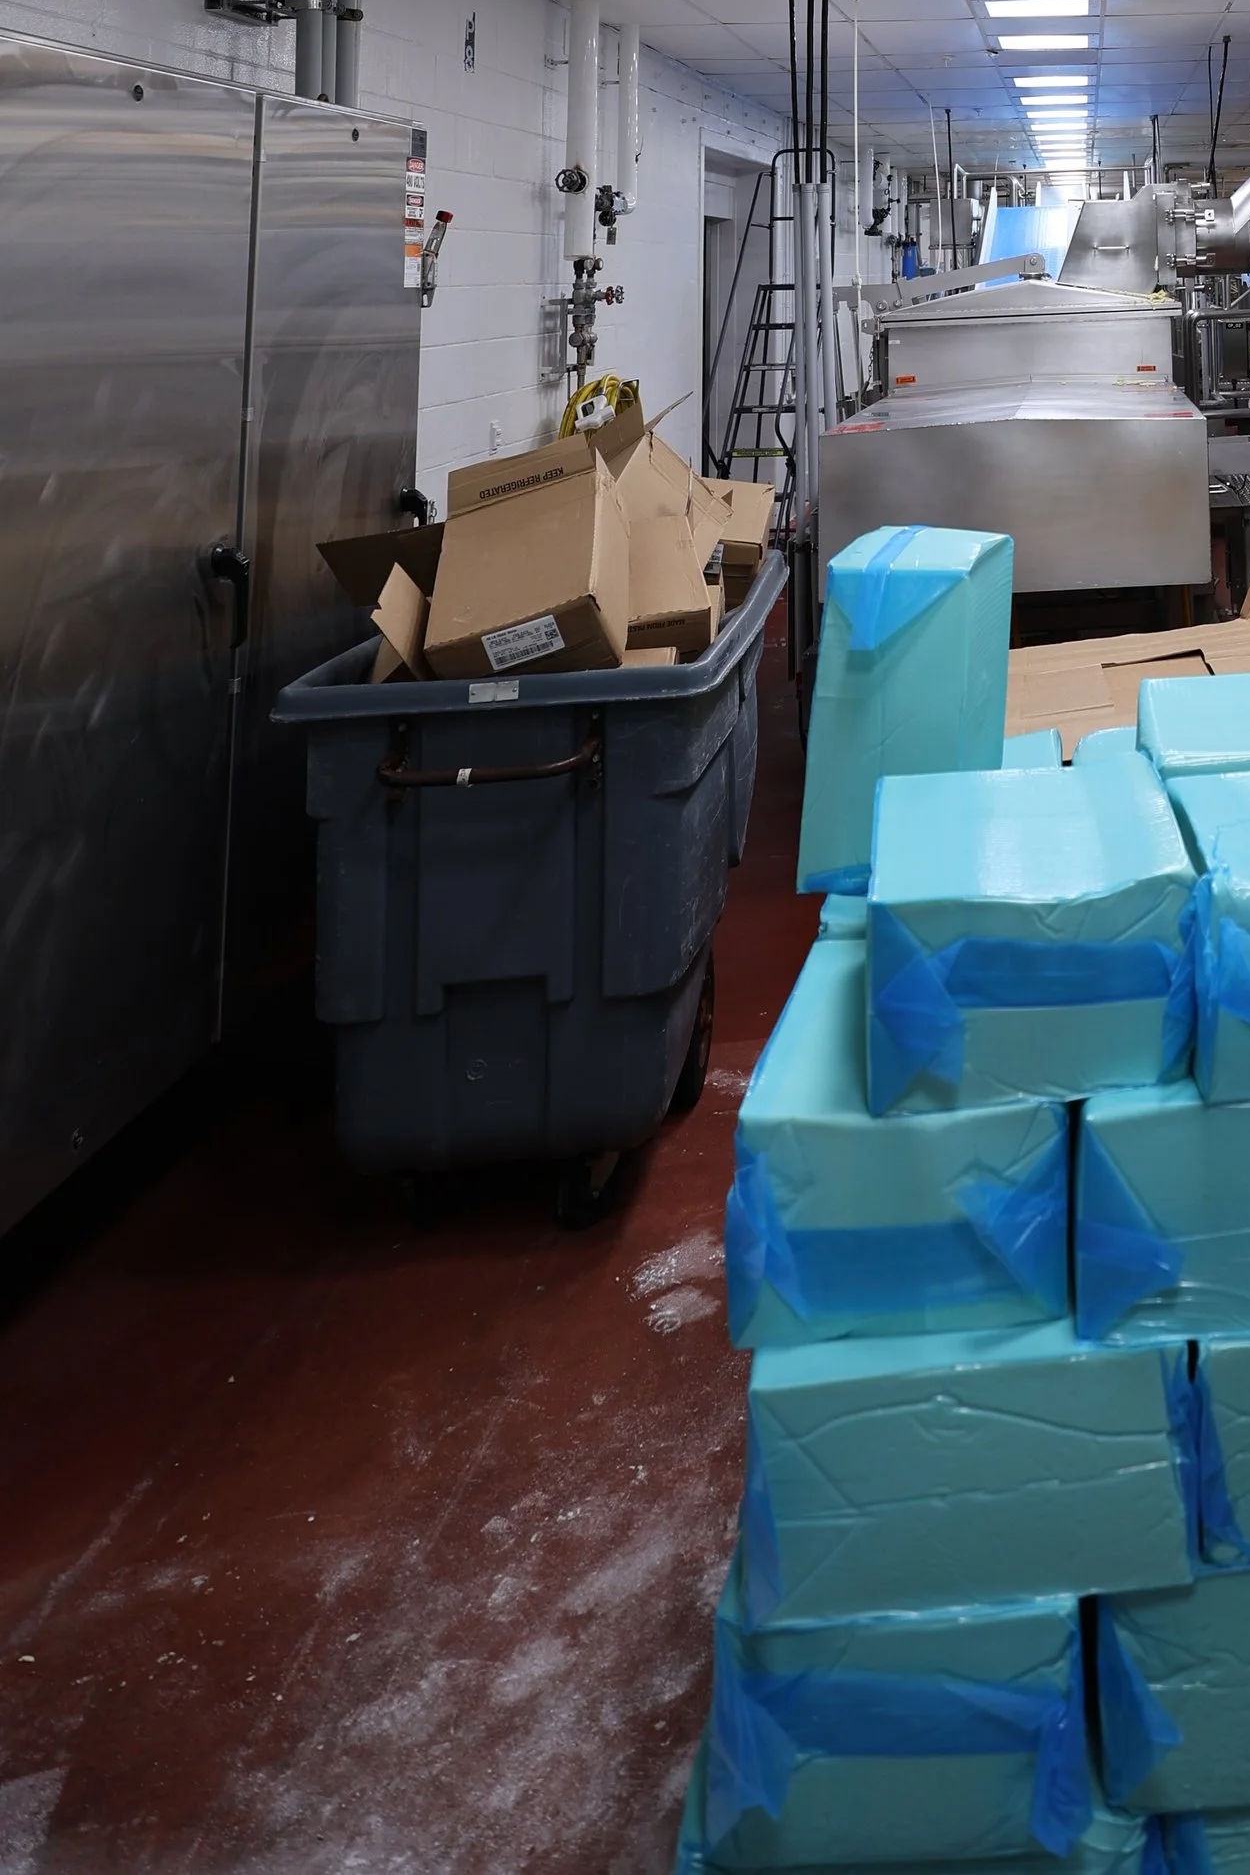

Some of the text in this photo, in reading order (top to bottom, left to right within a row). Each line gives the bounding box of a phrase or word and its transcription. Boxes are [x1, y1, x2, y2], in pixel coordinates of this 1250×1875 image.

[479, 467, 564, 499] KEEP REFRIGERATED
[647, 621, 666, 629] FROM
[666, 619, 686, 628] MADE
